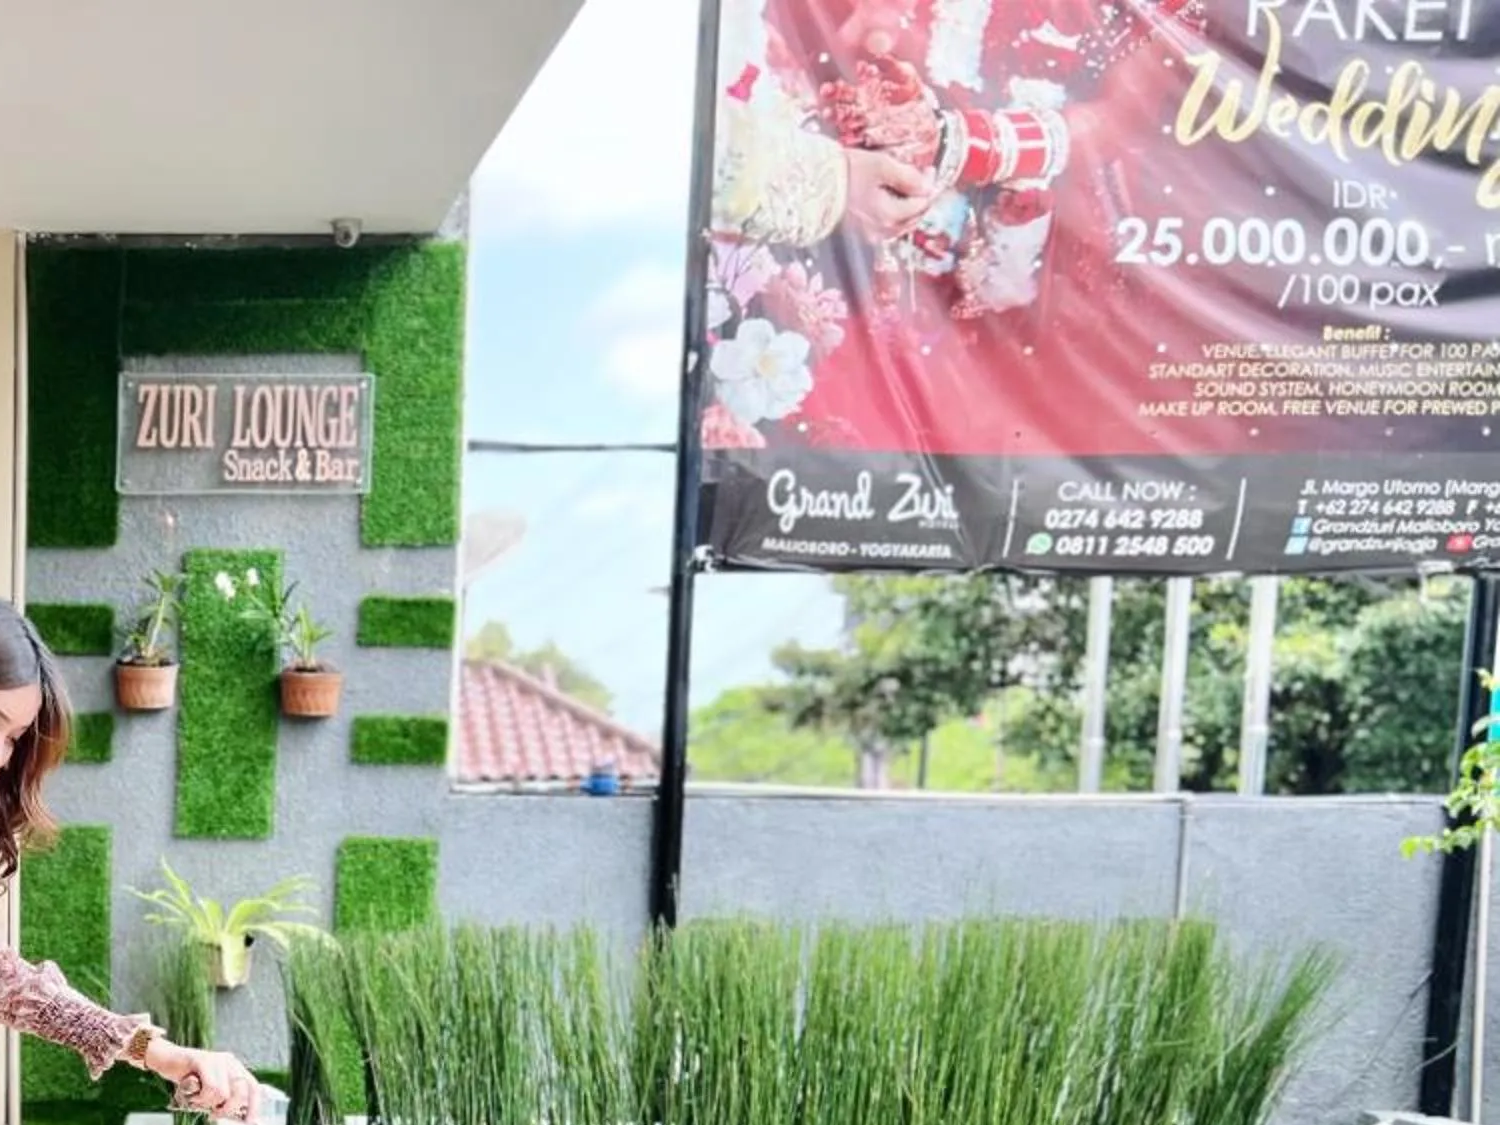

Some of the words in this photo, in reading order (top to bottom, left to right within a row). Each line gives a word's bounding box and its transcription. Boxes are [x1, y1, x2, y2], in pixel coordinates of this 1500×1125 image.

[1333, 179, 1388, 210] IDR
[1278, 273, 1360, 310] /100
[1369, 283, 1441, 309] pax
[1323, 325, 1382, 341] Benefit
[1400, 343, 1435, 359] FOR
[1441, 342, 1467, 359] 100
[1149, 362, 1235, 379] STANDART
[1359, 361, 1412, 378] MUSIC
[1194, 381, 1255, 398] SOUND
[1329, 380, 1444, 397] HONEYMOON
[137, 383, 217, 448] ZURI
[231, 384, 359, 449] LOUNGE
[1138, 401, 1189, 417] MAKE
[1191, 401, 1215, 417] UP
[1282, 400, 1321, 416] FREE
[1325, 400, 1380, 416] VENUE
[1383, 400, 1418, 416] FOR
[1421, 400, 1488, 416] PREWED
[223, 449, 292, 481] Snack
[295, 448, 313, 482] &
[1057, 481, 1116, 501] CALL
[1122, 481, 1185, 501] NOW
[1322, 480, 1379, 498] Margo
[1383, 479, 1441, 495] Utomo
[767, 468, 875, 533] Grand
[887, 472, 960, 522] Zuri
[1297, 500, 1308, 515] T
[1315, 500, 1347, 515] +62
[1348, 500, 1380, 515] 274
[1383, 500, 1413, 515] 642
[1416, 500, 1457, 515] 9288
[1044, 508, 1099, 529] 0274
[1103, 509, 1145, 529] 642
[1149, 509, 1204, 529] 9288
[761, 536, 848, 556] MALIOBORO
[860, 541, 952, 560] YOGYAKARTA
[1055, 535, 1109, 556] 0811
[1112, 534, 1168, 556] 2548
[1172, 535, 1215, 556] 500
